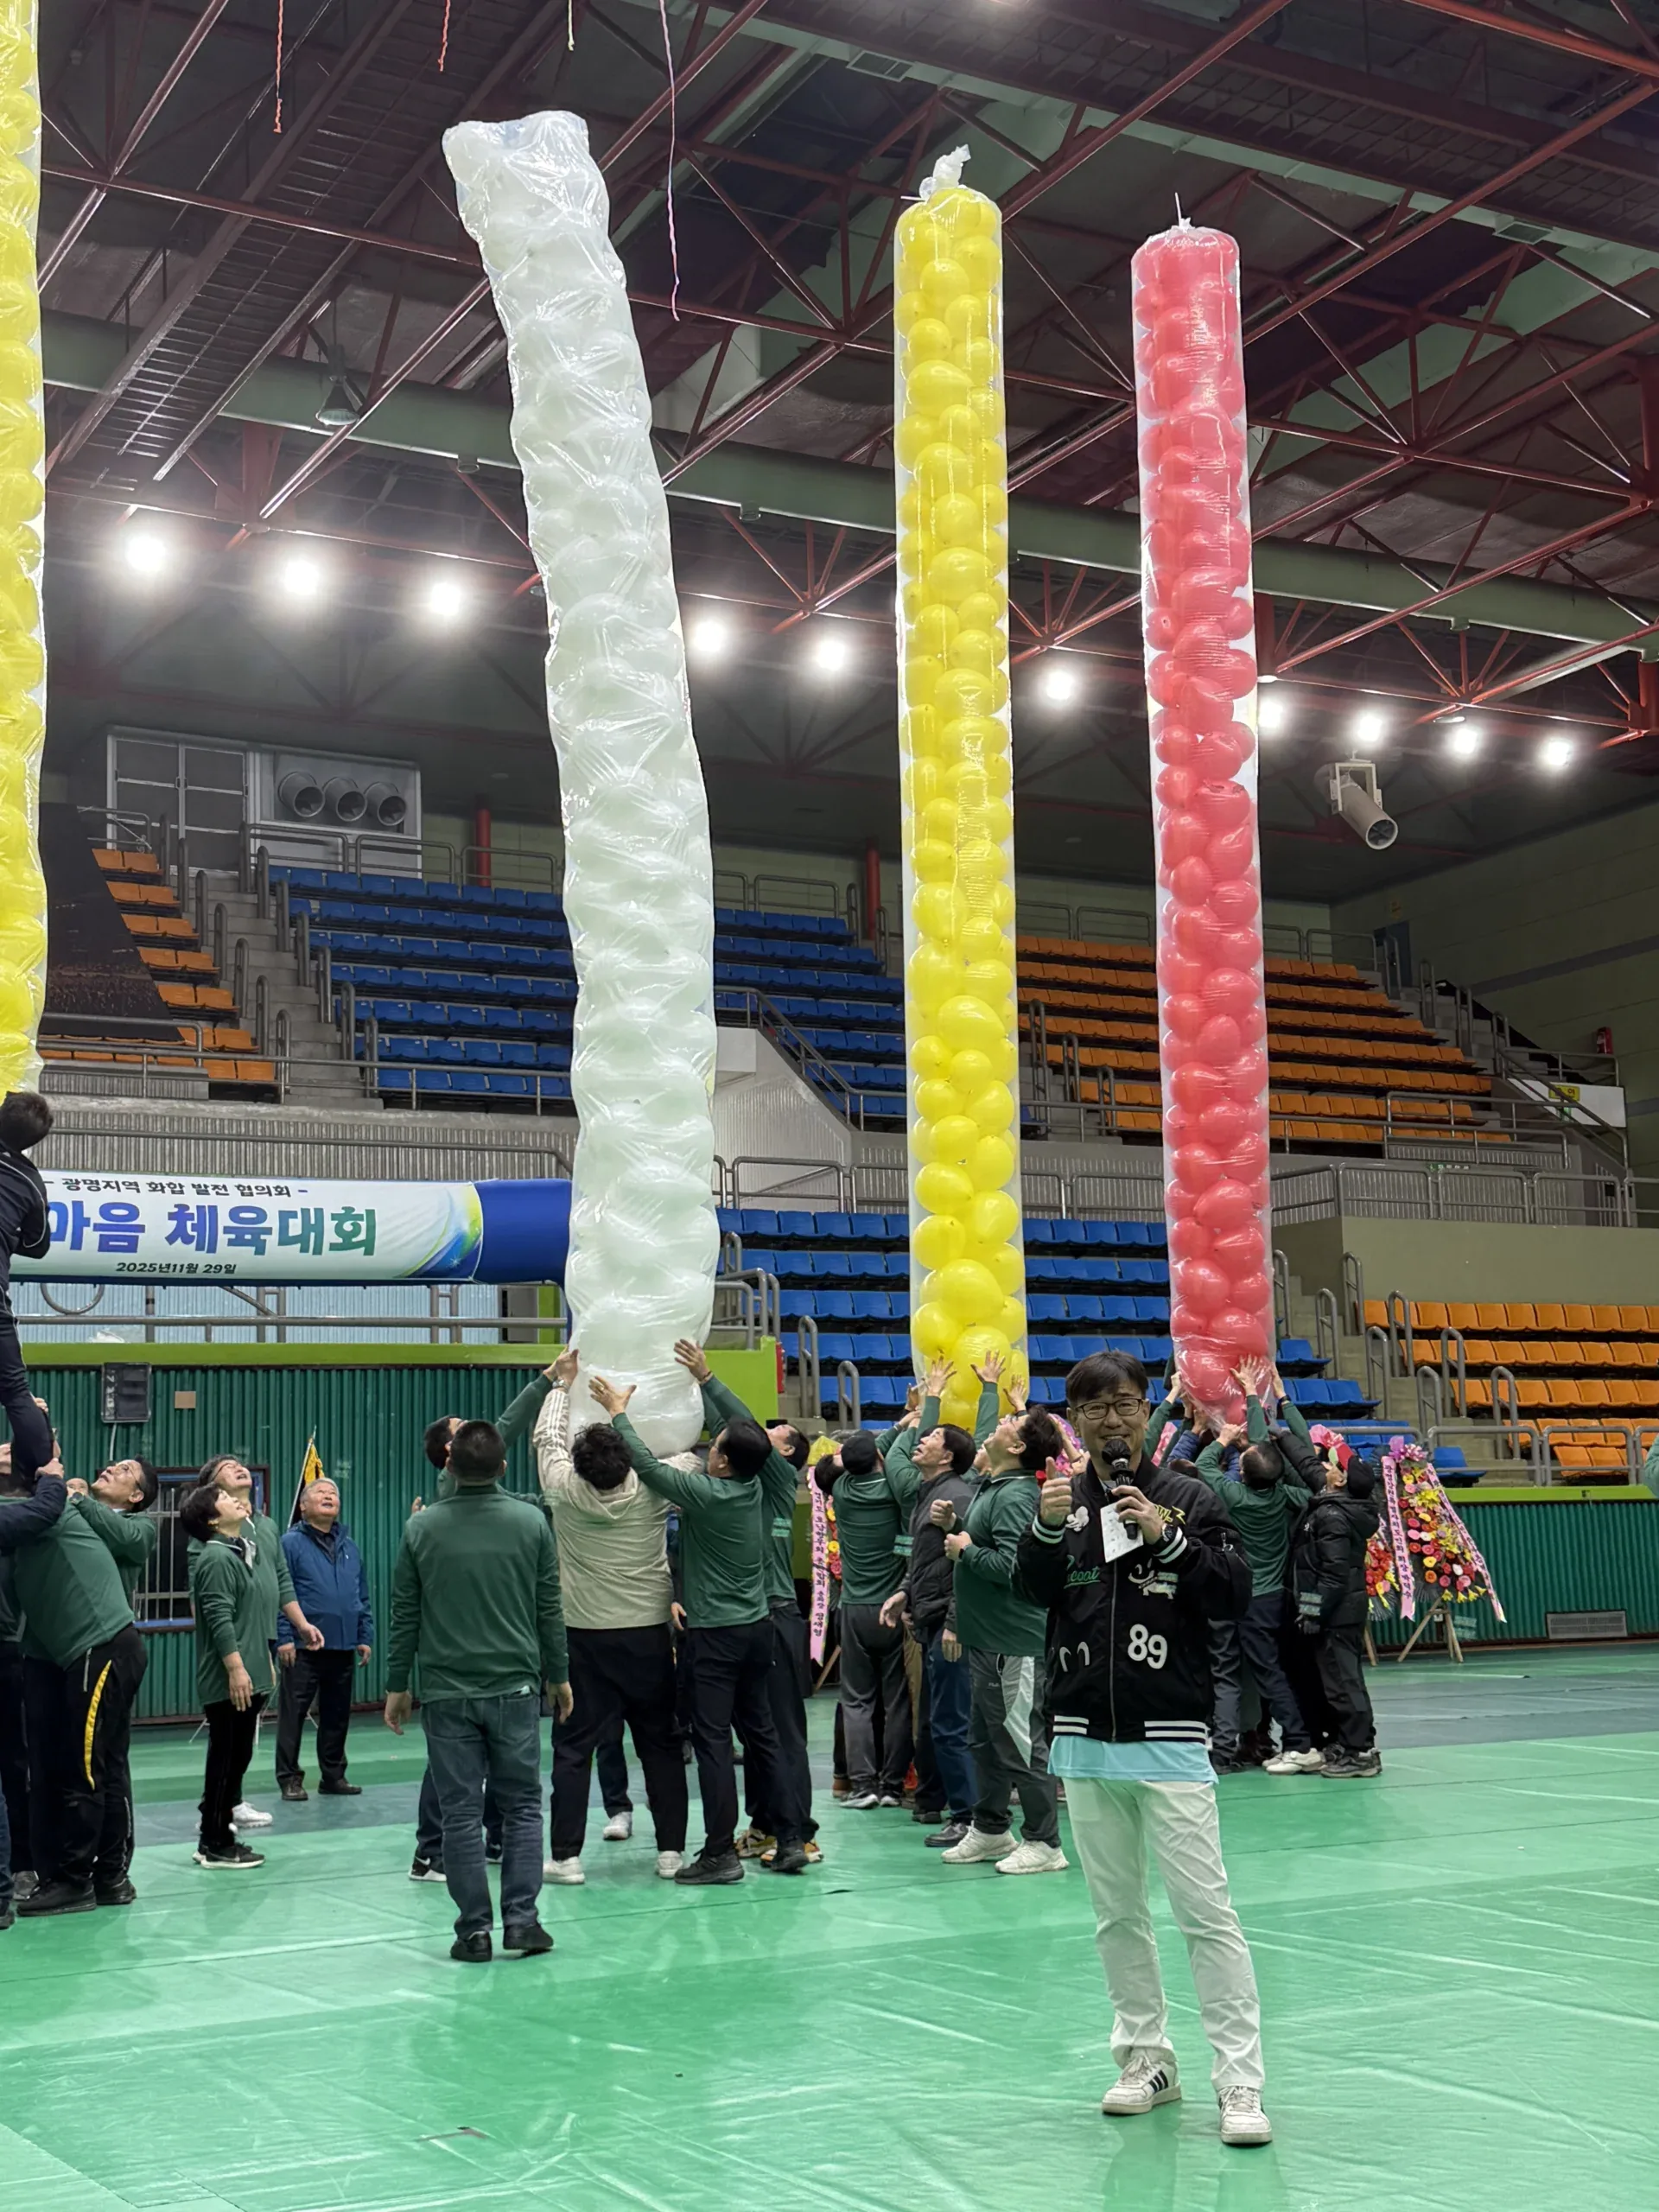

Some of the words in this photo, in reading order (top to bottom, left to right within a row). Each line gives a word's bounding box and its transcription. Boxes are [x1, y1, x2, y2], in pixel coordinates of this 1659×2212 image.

[62, 1178, 141, 1193] 광명지역
[146, 1181, 185, 1195] 화합
[191, 1183, 230, 1197] 발전
[235, 1184, 292, 1198] 협의회
[48, 1200, 146, 1254] 마음
[164, 1203, 377, 1256] 체육대회
[116, 1262, 199, 1274] 2025년11월
[202, 1264, 237, 1274] 29일
[1128, 1624, 1167, 1669] 89
